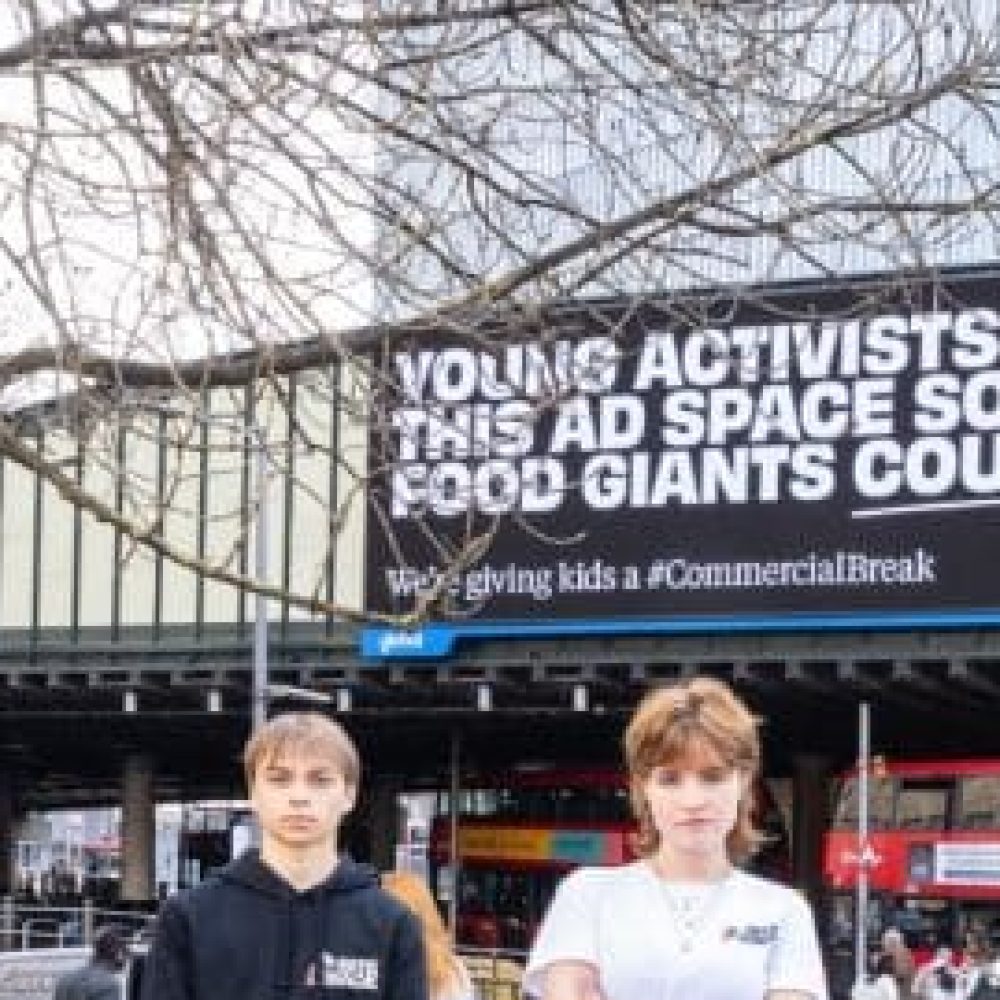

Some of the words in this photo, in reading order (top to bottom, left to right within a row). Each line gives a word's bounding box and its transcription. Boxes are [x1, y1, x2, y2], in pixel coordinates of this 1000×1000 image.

[395, 336, 616, 401] YOUNG
[633, 306, 1000, 388] ACTIVISTS
[392, 400, 534, 460] THIS
[551, 395, 646, 452] AD
[662, 378, 896, 446] SPACE
[392, 458, 565, 520] FOOD
[582, 443, 836, 512] GIANTS
[466, 562, 553, 601] giving
[558, 557, 616, 593] kids
[622, 566, 640, 590] a
[647, 548, 938, 592] #CommercialBreak
